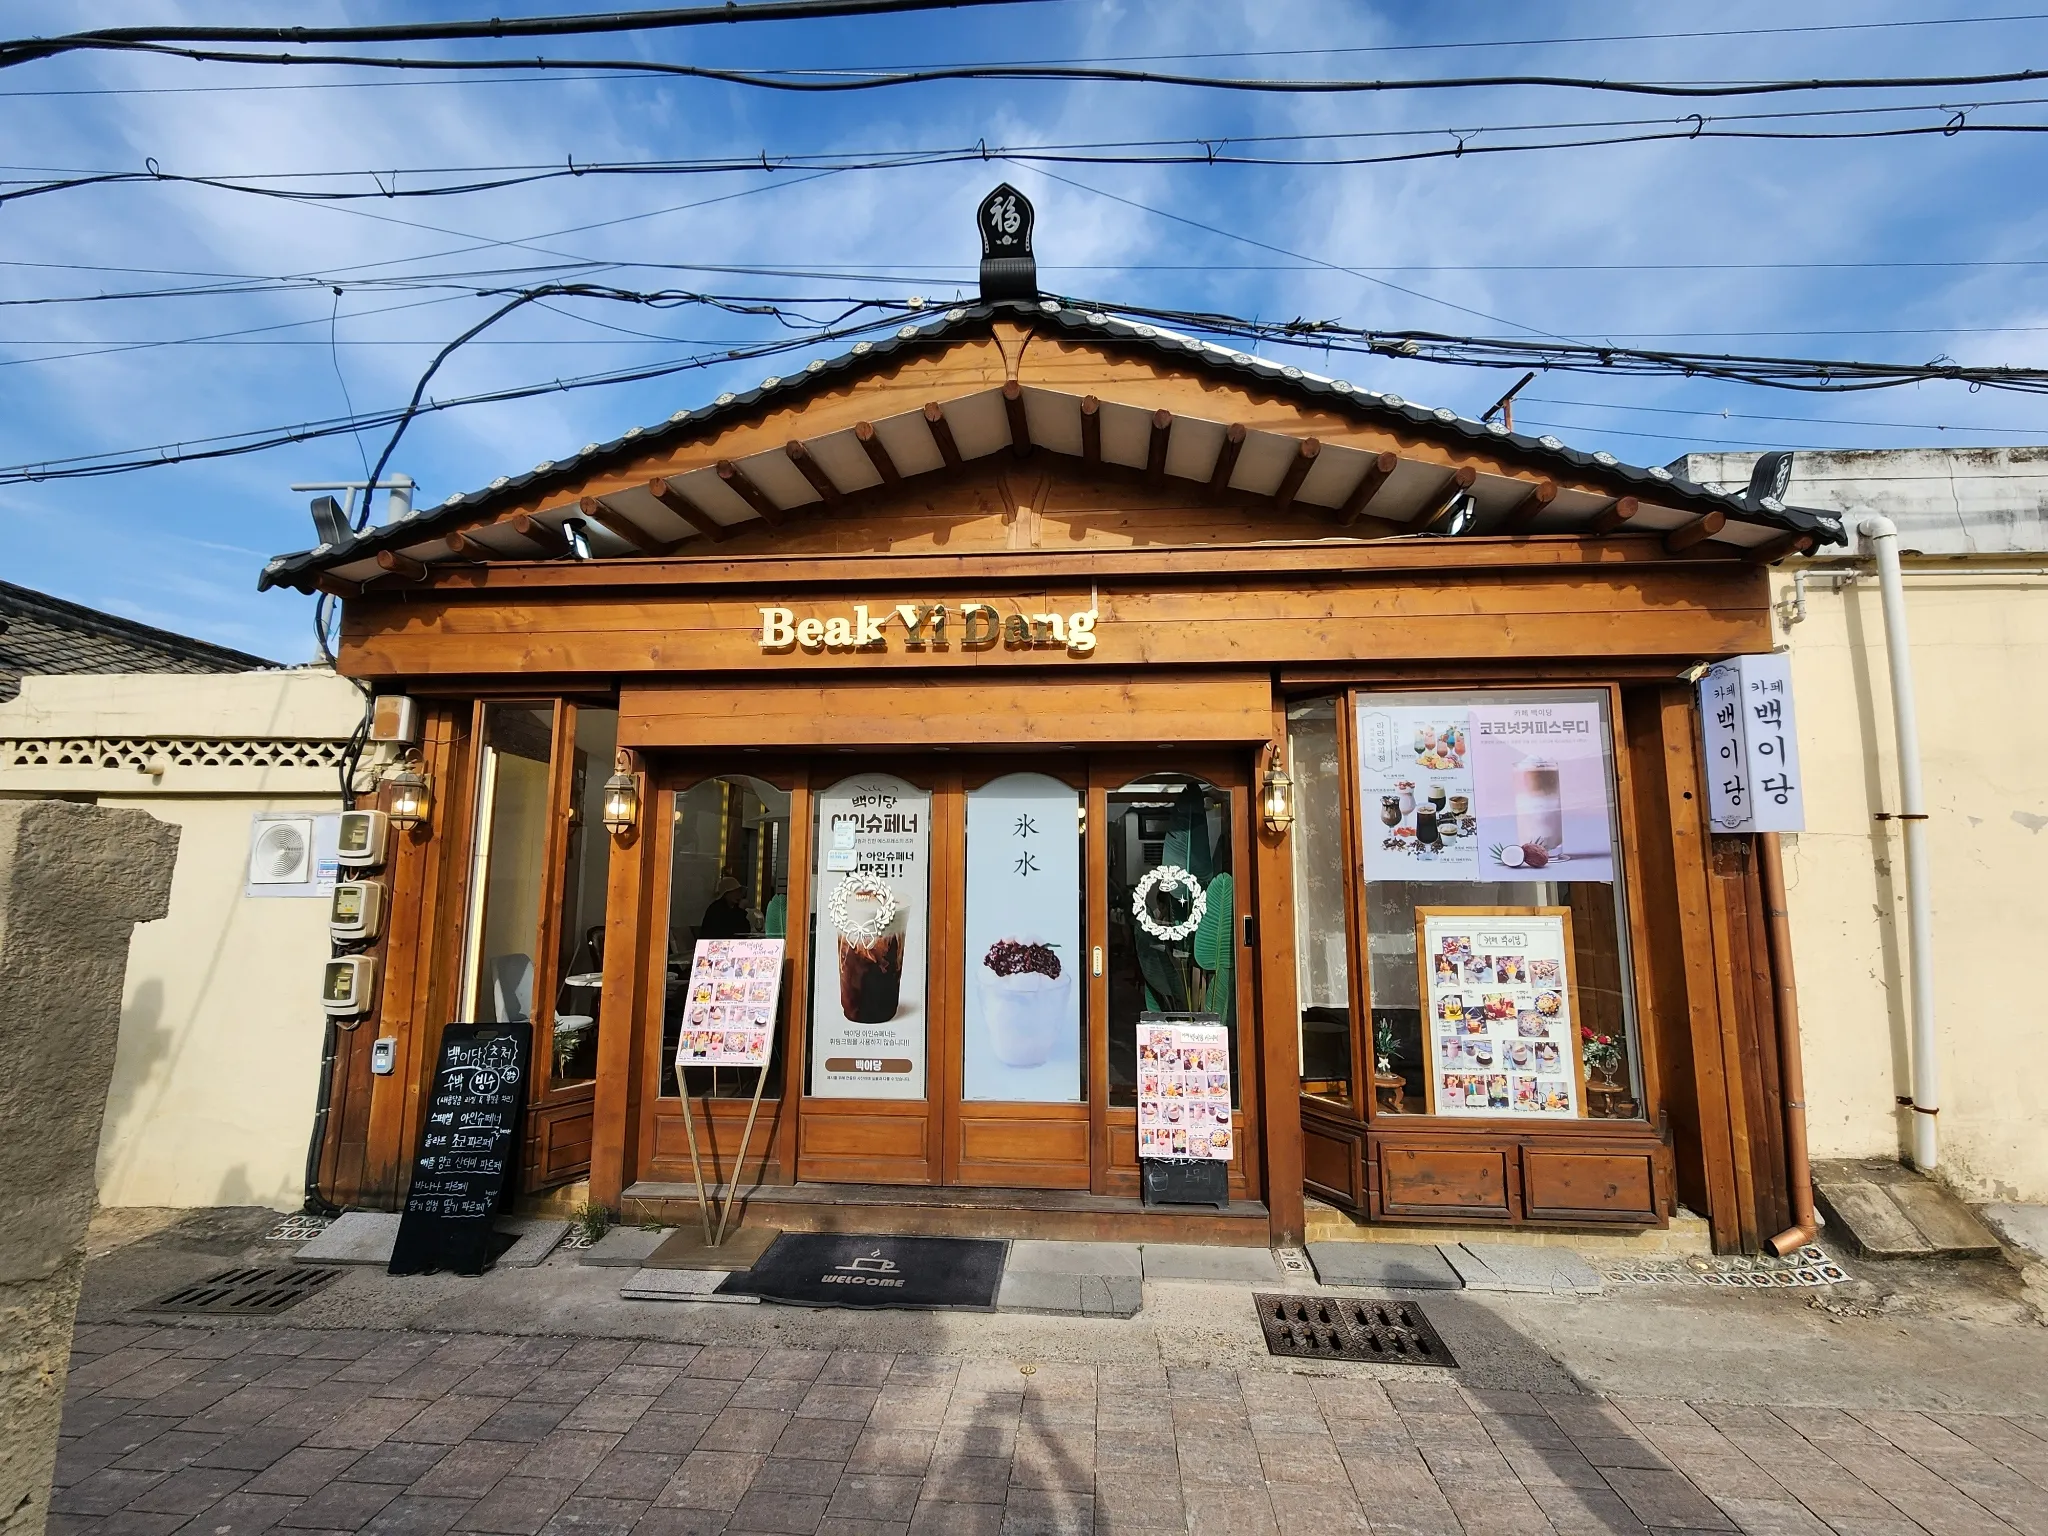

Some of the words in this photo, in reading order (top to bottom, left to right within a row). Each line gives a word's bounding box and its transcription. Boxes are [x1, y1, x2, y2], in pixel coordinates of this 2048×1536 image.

[990, 195, 1021, 234] 福
[758, 605, 886, 649] Beak
[896, 604, 949, 646] Yi
[960, 604, 1099, 652] Dang
[1714, 682, 1736, 701] 카페
[1751, 679, 1784, 695] 카페
[1480, 720, 1589, 735] 코코넛커피스무디
[1717, 702, 1745, 806] 백이당
[1754, 698, 1795, 805] 백이당
[852, 794, 898, 809] 백이당
[866, 852, 914, 862] 아인슈페너
[447, 1045, 483, 1068] 백이당
[855, 1059, 882, 1072] 백이당
[443, 1072, 465, 1093] 수박
[475, 1072, 496, 1091] 빙수
[430, 1111, 454, 1126] 스페셜
[460, 1111, 502, 1126] 아인슈페너
[438, 1155, 452, 1170] 망고
[454, 1156, 477, 1169] 산더미
[480, 1158, 502, 1171] 파르페
[414, 1181, 441, 1192] 바나나
[444, 1181, 469, 1192] 파르페
[409, 1199, 424, 1212] 딸기
[443, 1198, 458, 1214] 딸기
[461, 1200, 486, 1213] 파르페
[821, 1274, 906, 1288] WELCOME
